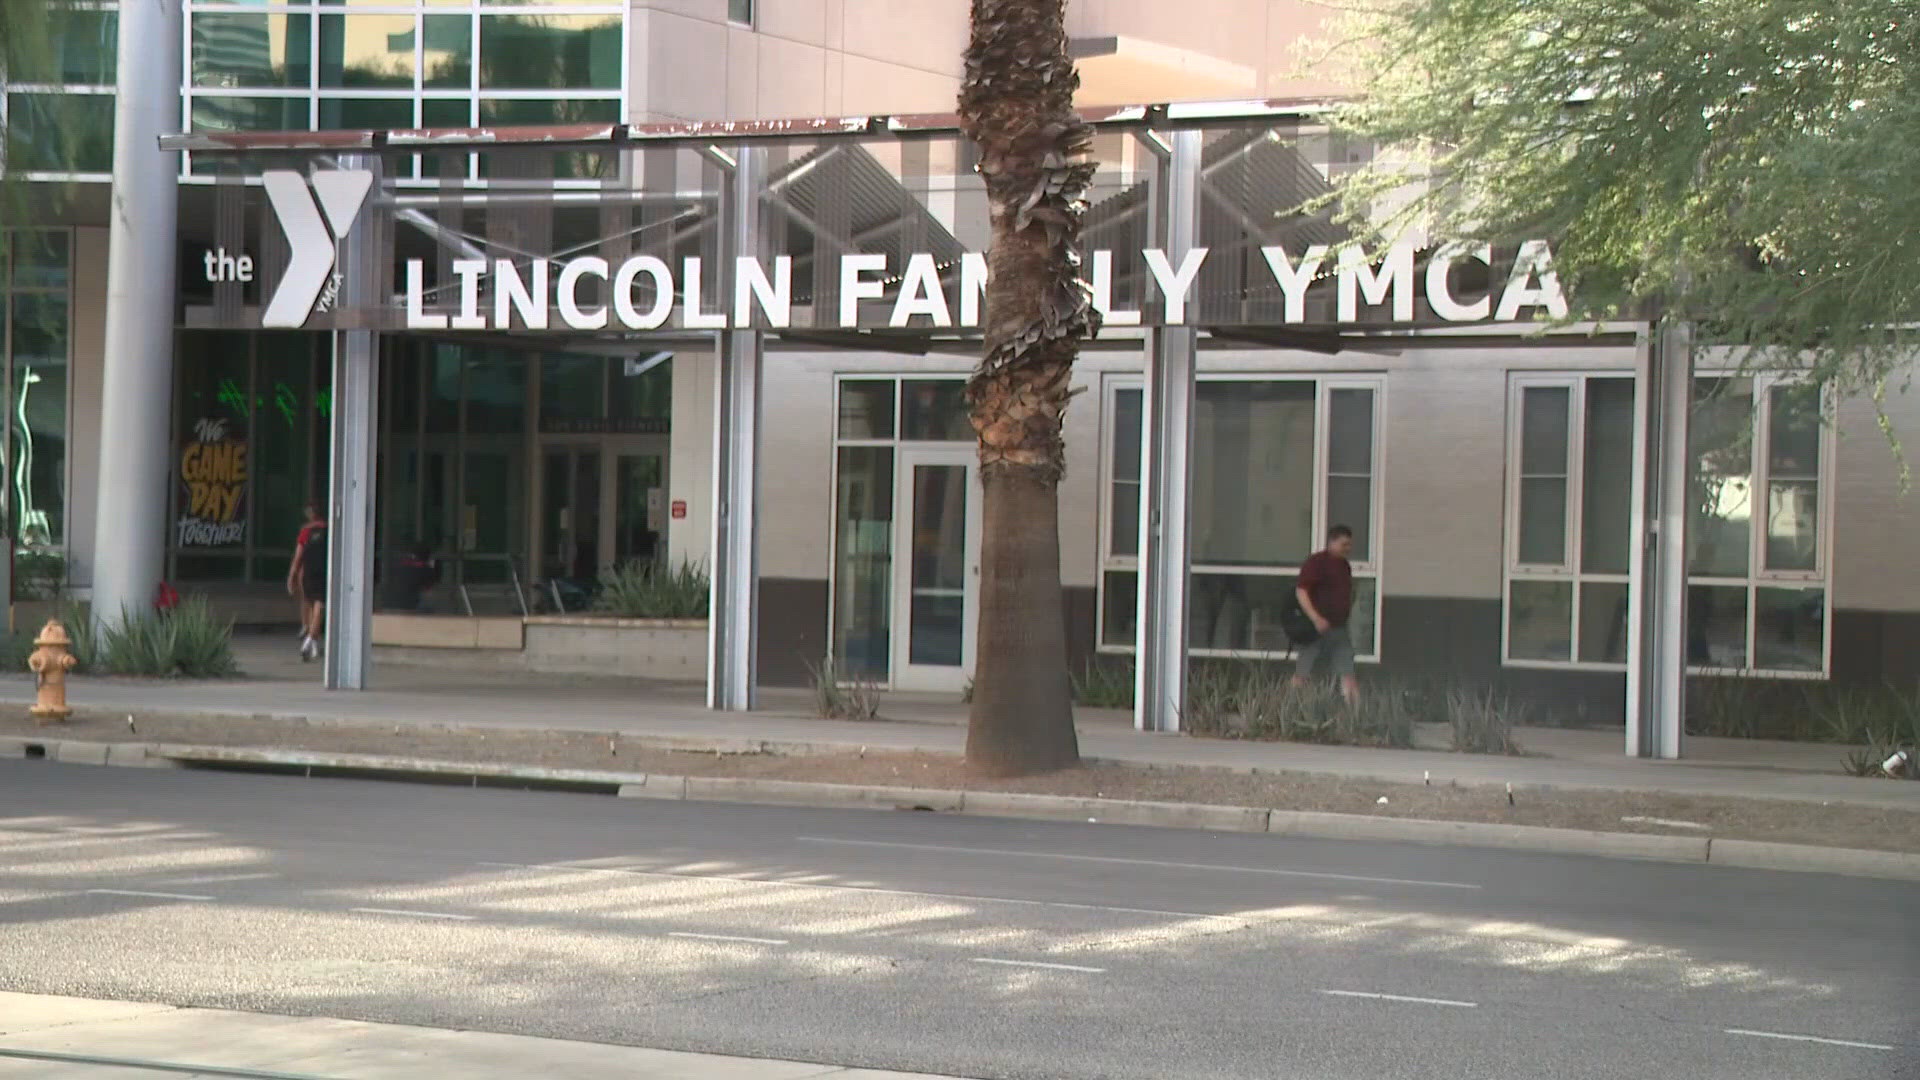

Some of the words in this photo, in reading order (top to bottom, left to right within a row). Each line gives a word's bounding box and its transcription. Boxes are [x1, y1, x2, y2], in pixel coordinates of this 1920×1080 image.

[204, 247, 253, 282] the
[406, 255, 792, 330] LINCOLN
[840, 248, 1210, 328] FALY
[1261, 240, 1569, 324] YMCA
[316, 272, 345, 313] YMCA
[181, 440, 248, 483] GAME
[190, 480, 243, 523] DAY
